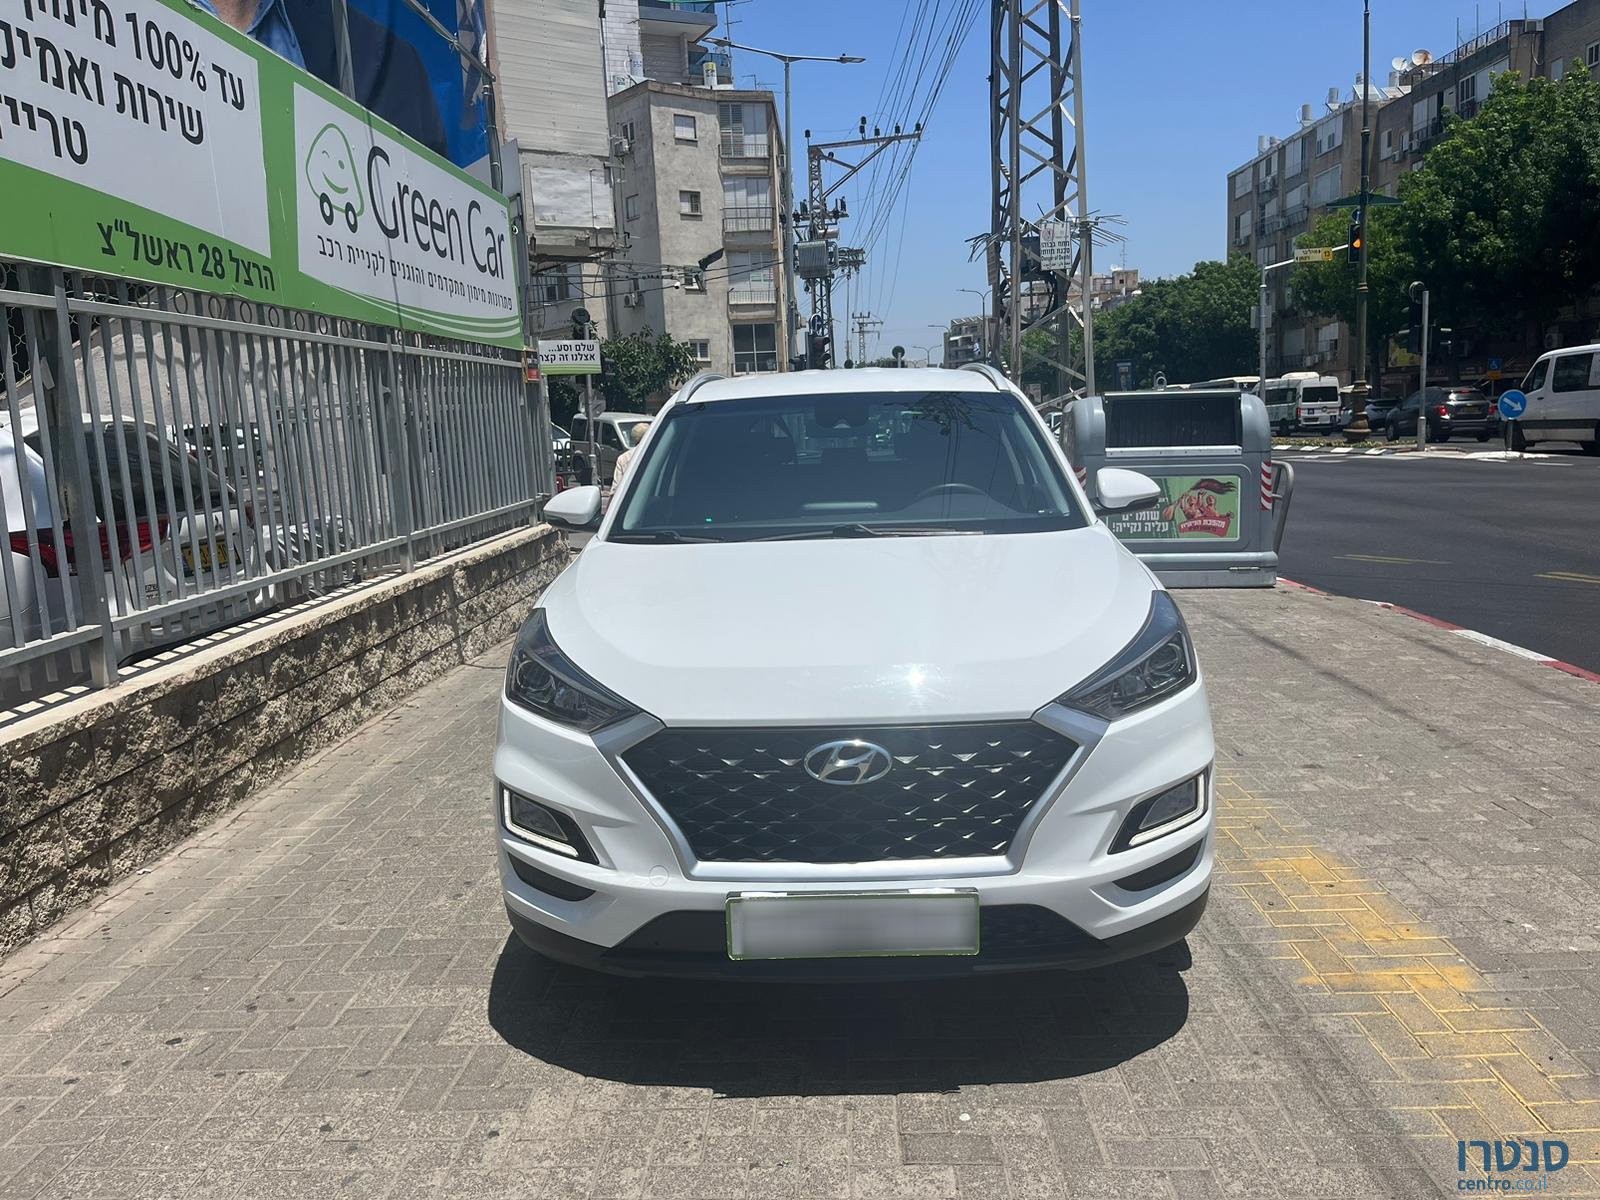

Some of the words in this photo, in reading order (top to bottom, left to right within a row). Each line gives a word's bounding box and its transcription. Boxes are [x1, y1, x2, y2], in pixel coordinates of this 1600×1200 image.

[125, 13, 207, 92] 100%
[211, 63, 246, 111] עד
[113, 72, 204, 145] שירות
[0, 94, 89, 165] טריי
[367, 146, 465, 265] Green
[467, 200, 506, 280] Car
[317, 233, 344, 260] רכב
[346, 243, 386, 277] לקניית
[197, 242, 226, 281] 28
[228, 248, 276, 292] הרצל
[390, 258, 426, 286] והוגנים
[428, 271, 466, 299] מתקדמים
[466, 282, 487, 303] מימון
[487, 289, 513, 312] פתרונות
[548, 344, 573, 352] וסע...
[559, 353, 569, 361] זה
[571, 352, 596, 361] אצלנו
[575, 342, 595, 352] שלם
[1144, 520, 1169, 533] עליה
